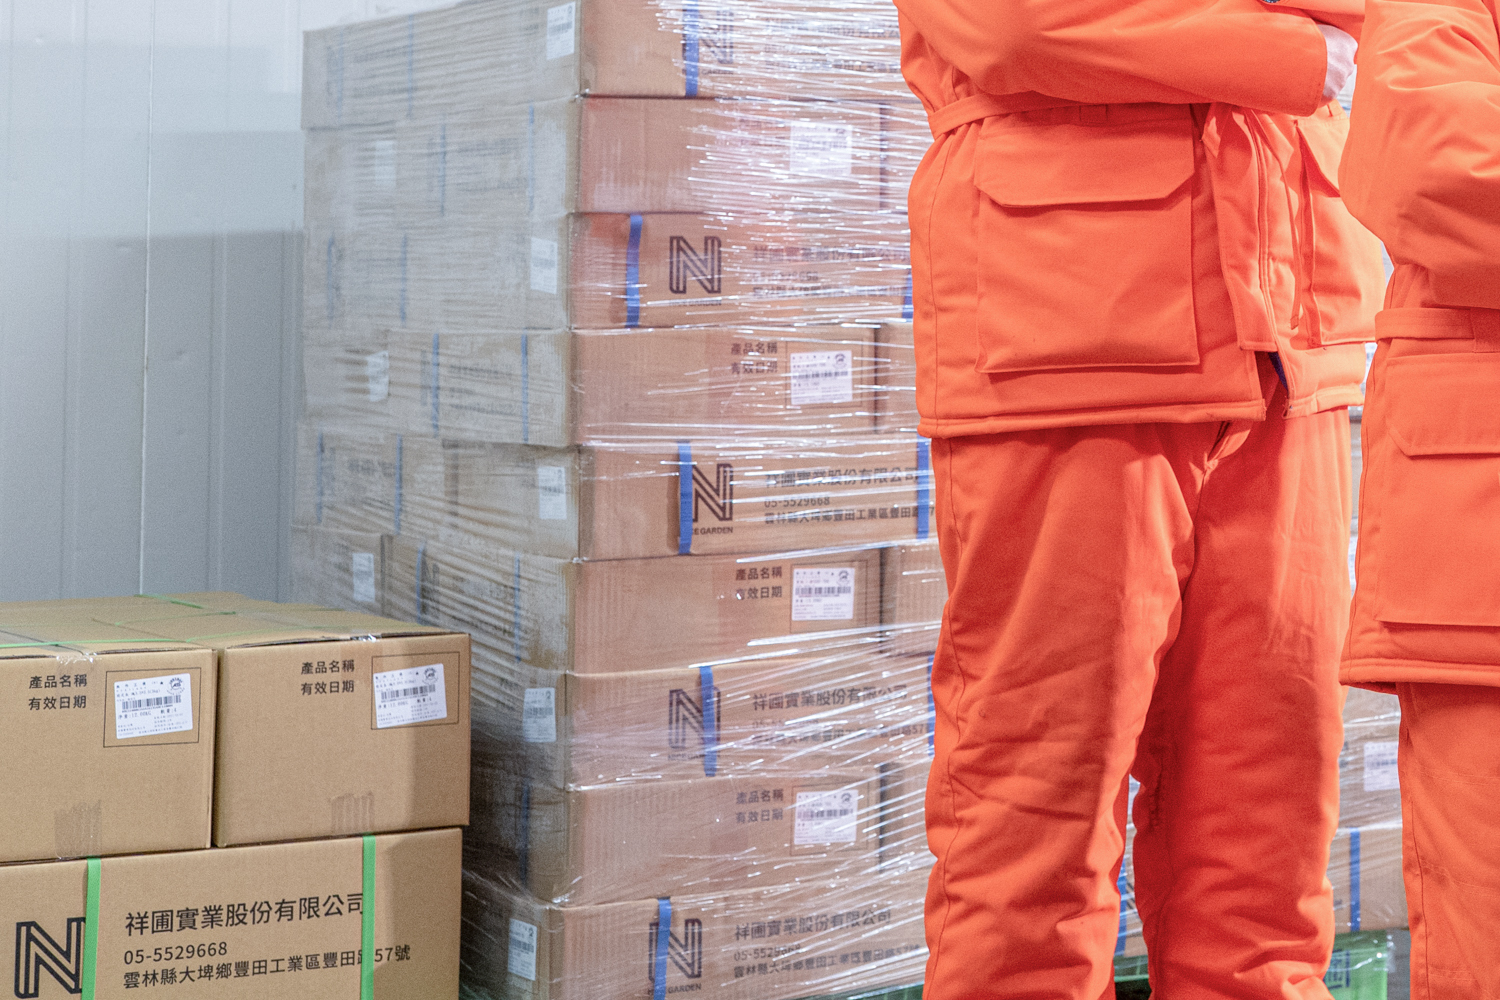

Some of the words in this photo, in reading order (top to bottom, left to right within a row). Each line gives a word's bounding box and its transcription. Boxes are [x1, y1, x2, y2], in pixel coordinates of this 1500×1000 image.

[669, 236, 721, 294] N
[700, 527, 734, 535] GARDEN
[736, 566, 782, 580] 產品名稱
[736, 586, 782, 600] 有效日期
[301, 659, 355, 675] 產品名稱
[29, 673, 87, 689] 產品名稱
[301, 680, 355, 695] 有效日期
[28, 695, 87, 710] 有效日期
[736, 789, 784, 804] 產品名稱
[736, 808, 784, 823] 有效日期
[125, 893, 363, 937] 祥圃實業股份有限公司
[734, 909, 892, 940] 祥圃實業股份有限公司
[14, 917, 86, 999] N
[124, 941, 228, 965] 05-5529668
[648, 918, 702, 983] N
[668, 983, 702, 994] GARDEN
